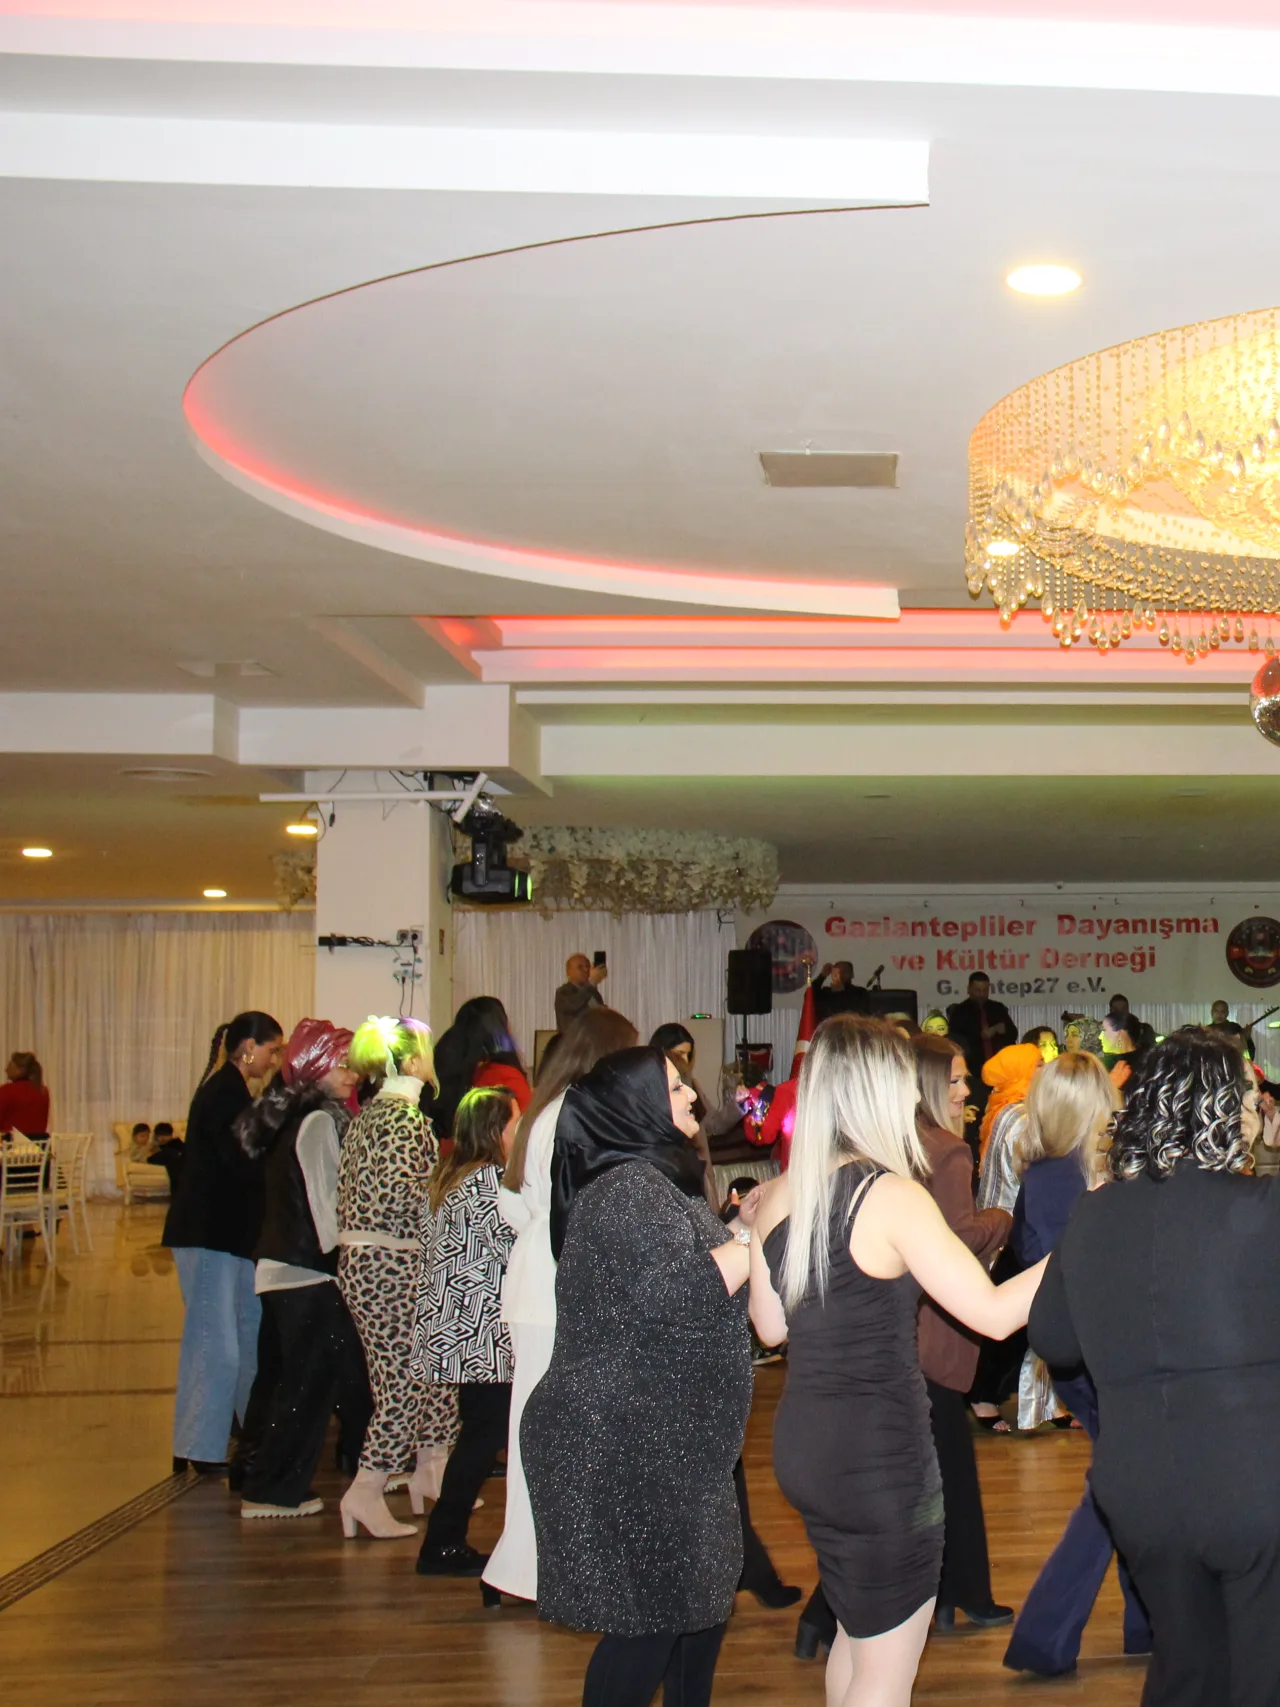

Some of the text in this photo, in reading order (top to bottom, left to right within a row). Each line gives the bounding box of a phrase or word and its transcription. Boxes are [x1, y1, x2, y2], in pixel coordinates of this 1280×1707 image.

[825, 914, 1219, 942] Gaziantepliler Dayanışma
[891, 946, 1156, 974] ve Kültür Derneği
[1067, 976, 1106, 994] e.V.
